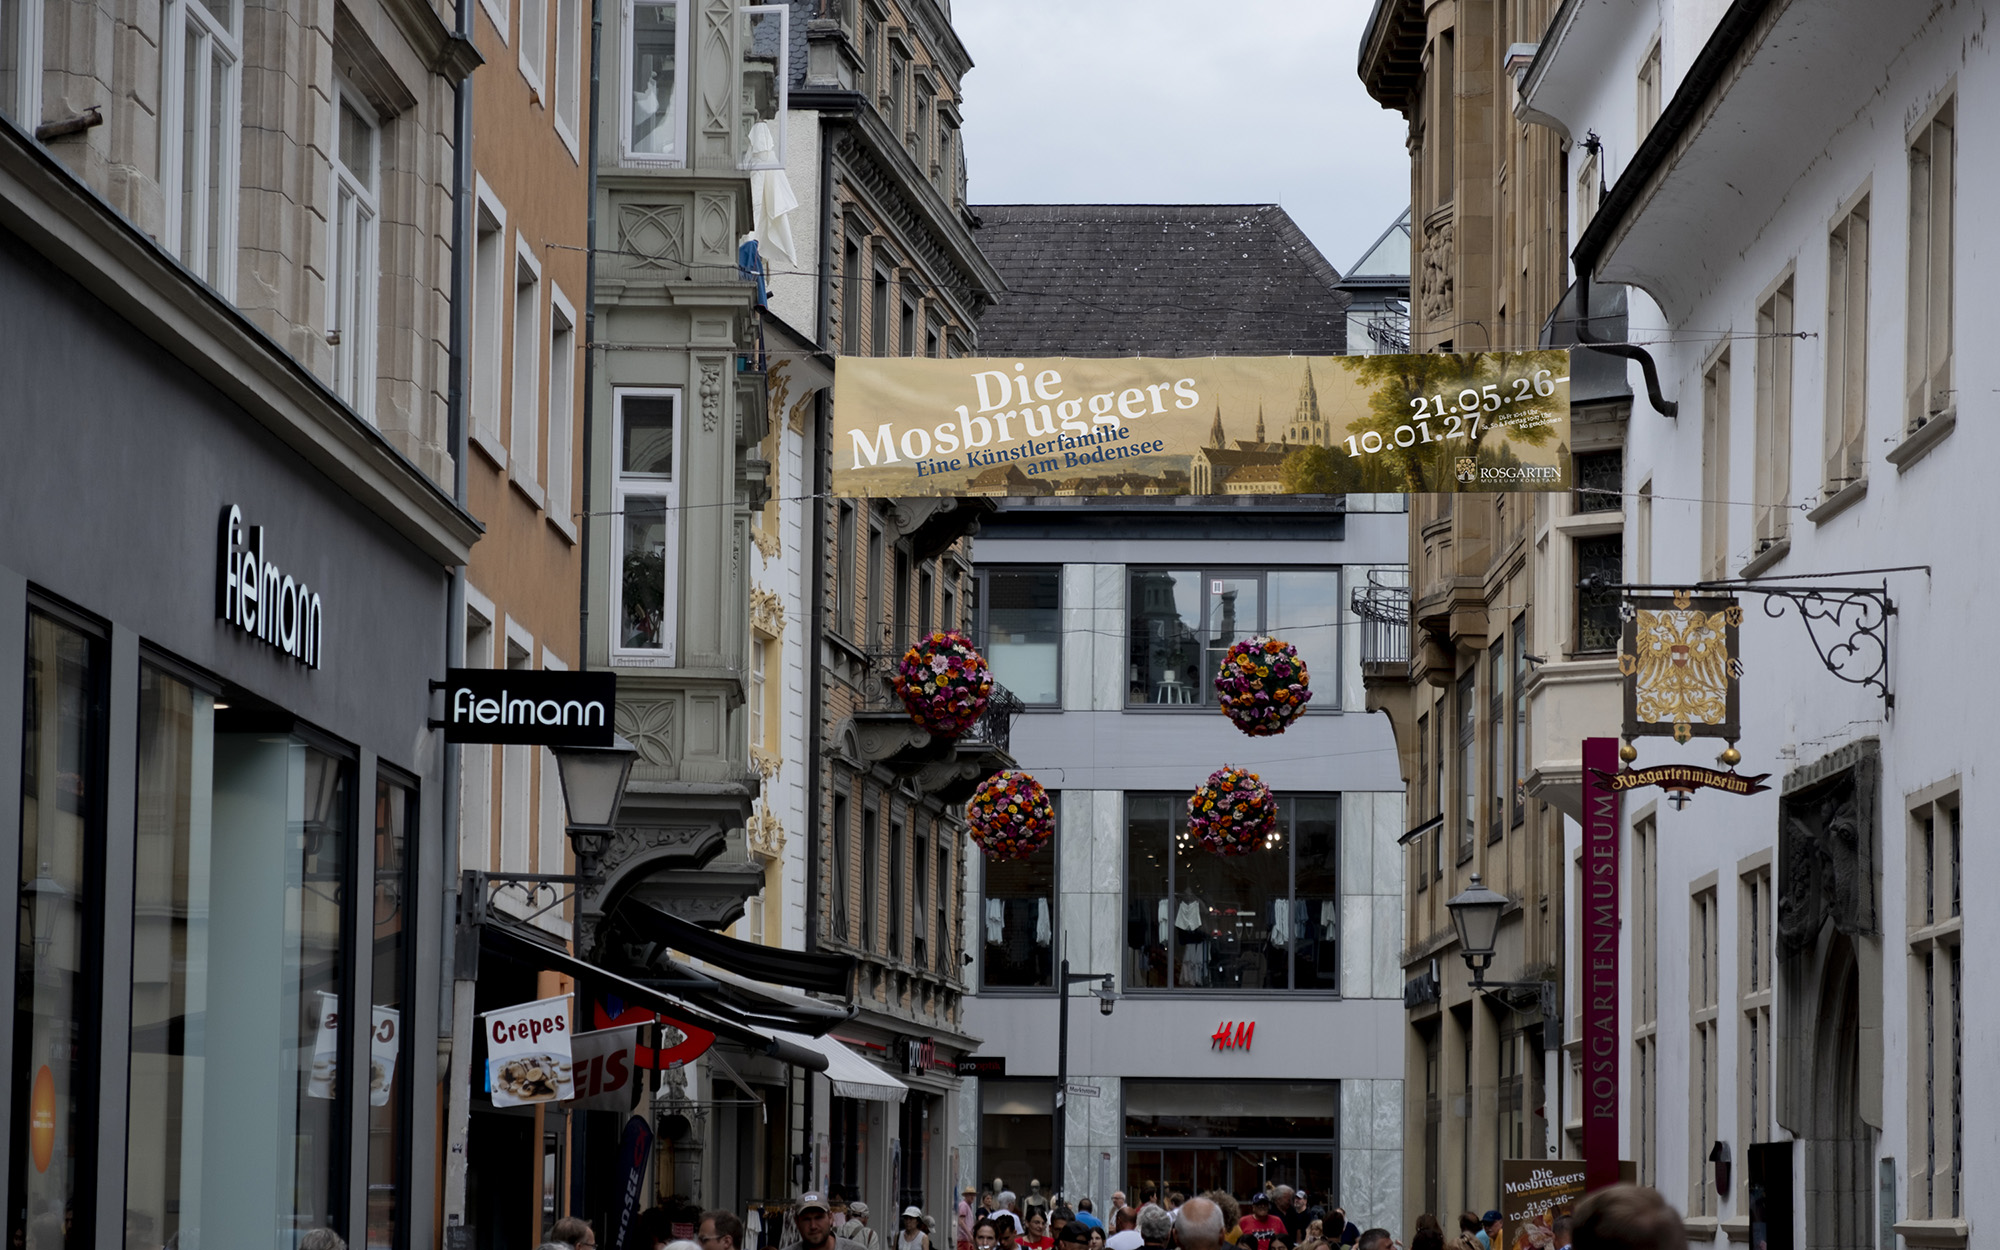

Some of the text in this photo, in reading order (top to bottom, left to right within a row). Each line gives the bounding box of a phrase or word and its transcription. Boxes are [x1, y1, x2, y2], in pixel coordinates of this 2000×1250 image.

[971, 362, 1064, 413] Die
[847, 377, 1200, 471] Mosbruggers
[1344, 411, 1481, 458] 10.01.27
[915, 423, 1130, 478] Eine Künstlerfamilie
[1026, 438, 1164, 476] am Bodensee
[1480, 467, 1562, 478] ROSGARTEN
[225, 504, 321, 670] fielmann
[453, 687, 605, 727] fielmann
[1592, 795, 1614, 1119] ROSGARTENMUSEUM
[492, 1014, 565, 1044] Crêpes
[1211, 1021, 1255, 1050] H&M
[565, 1049, 629, 1101] EIS
[1505, 1172, 1585, 1194] Mosbruggers
[1533, 1168, 1553, 1181] Die
[1509, 1207, 1548, 1221] 10.01.27
